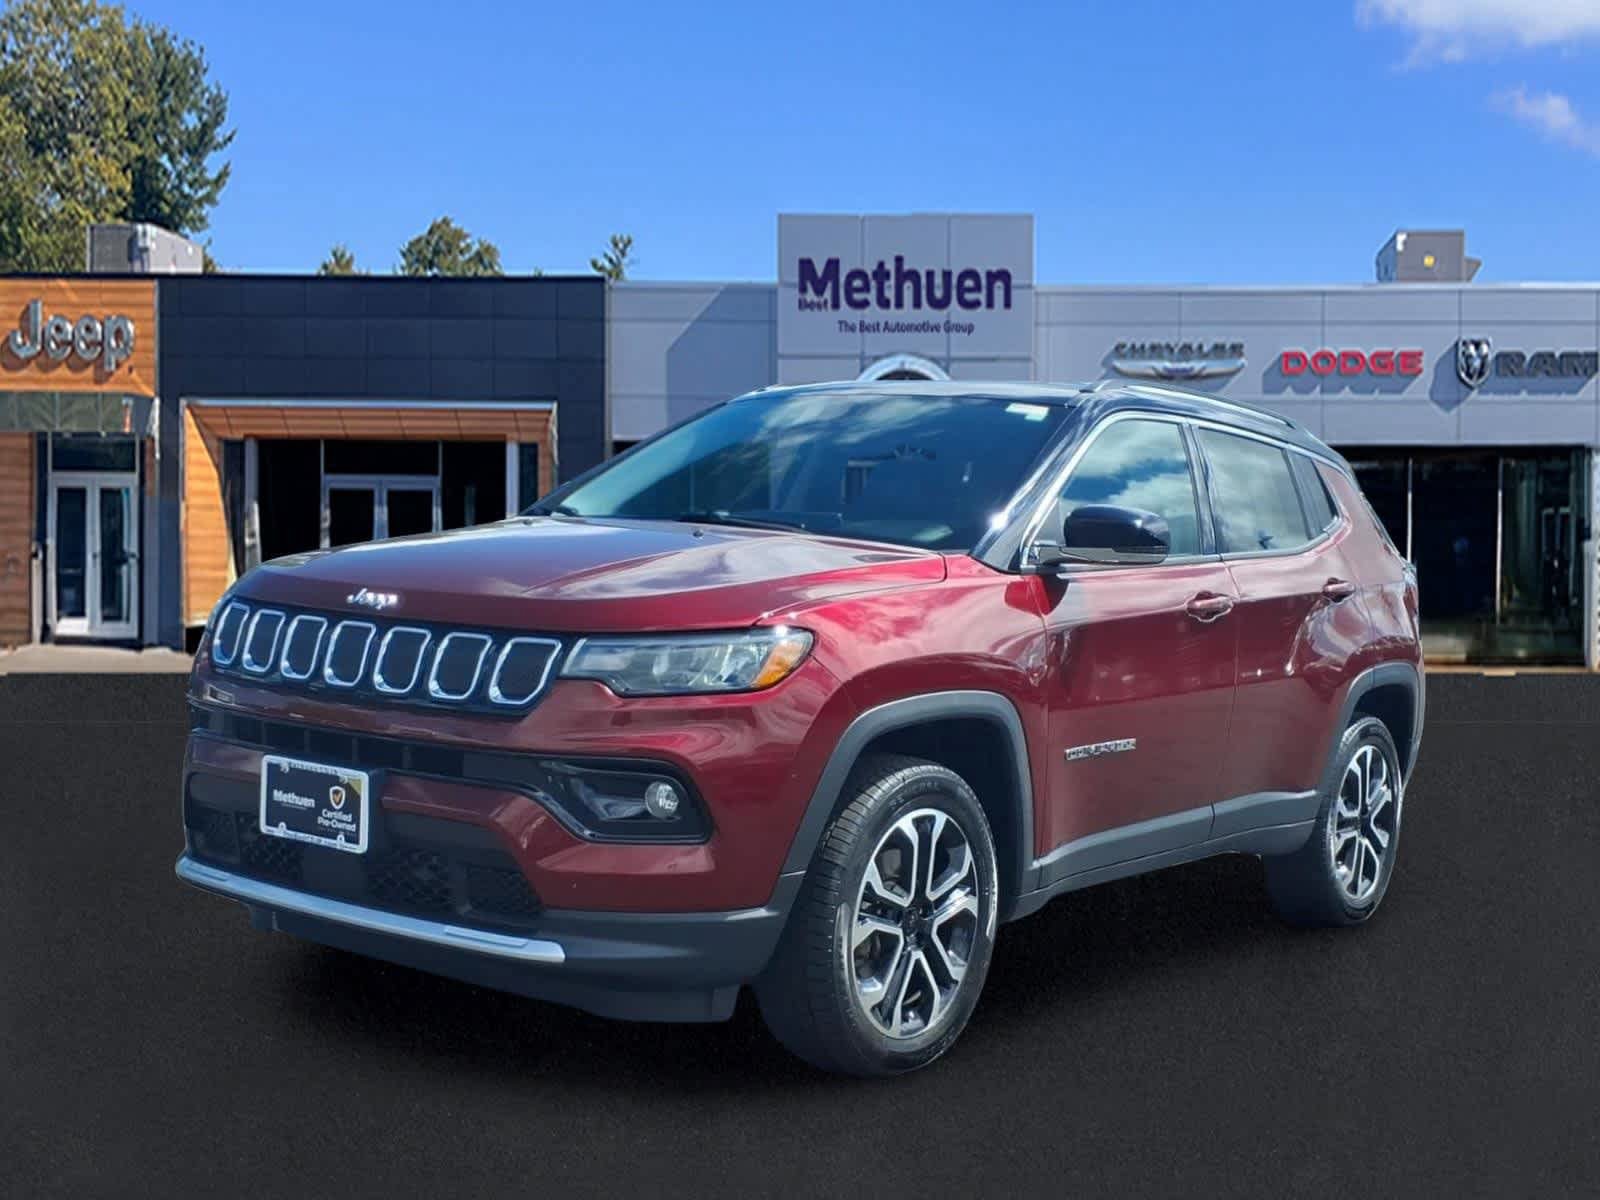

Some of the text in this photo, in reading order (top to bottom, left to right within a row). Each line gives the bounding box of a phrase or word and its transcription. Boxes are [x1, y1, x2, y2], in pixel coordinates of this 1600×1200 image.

[798, 255, 1012, 311] Methuen
[9, 299, 134, 372] Jeep
[838, 319, 975, 335] The Best Automotive Group
[1281, 350, 1424, 375] DODGE
[1494, 351, 1599, 378] RAM
[273, 789, 315, 808] Methuen
